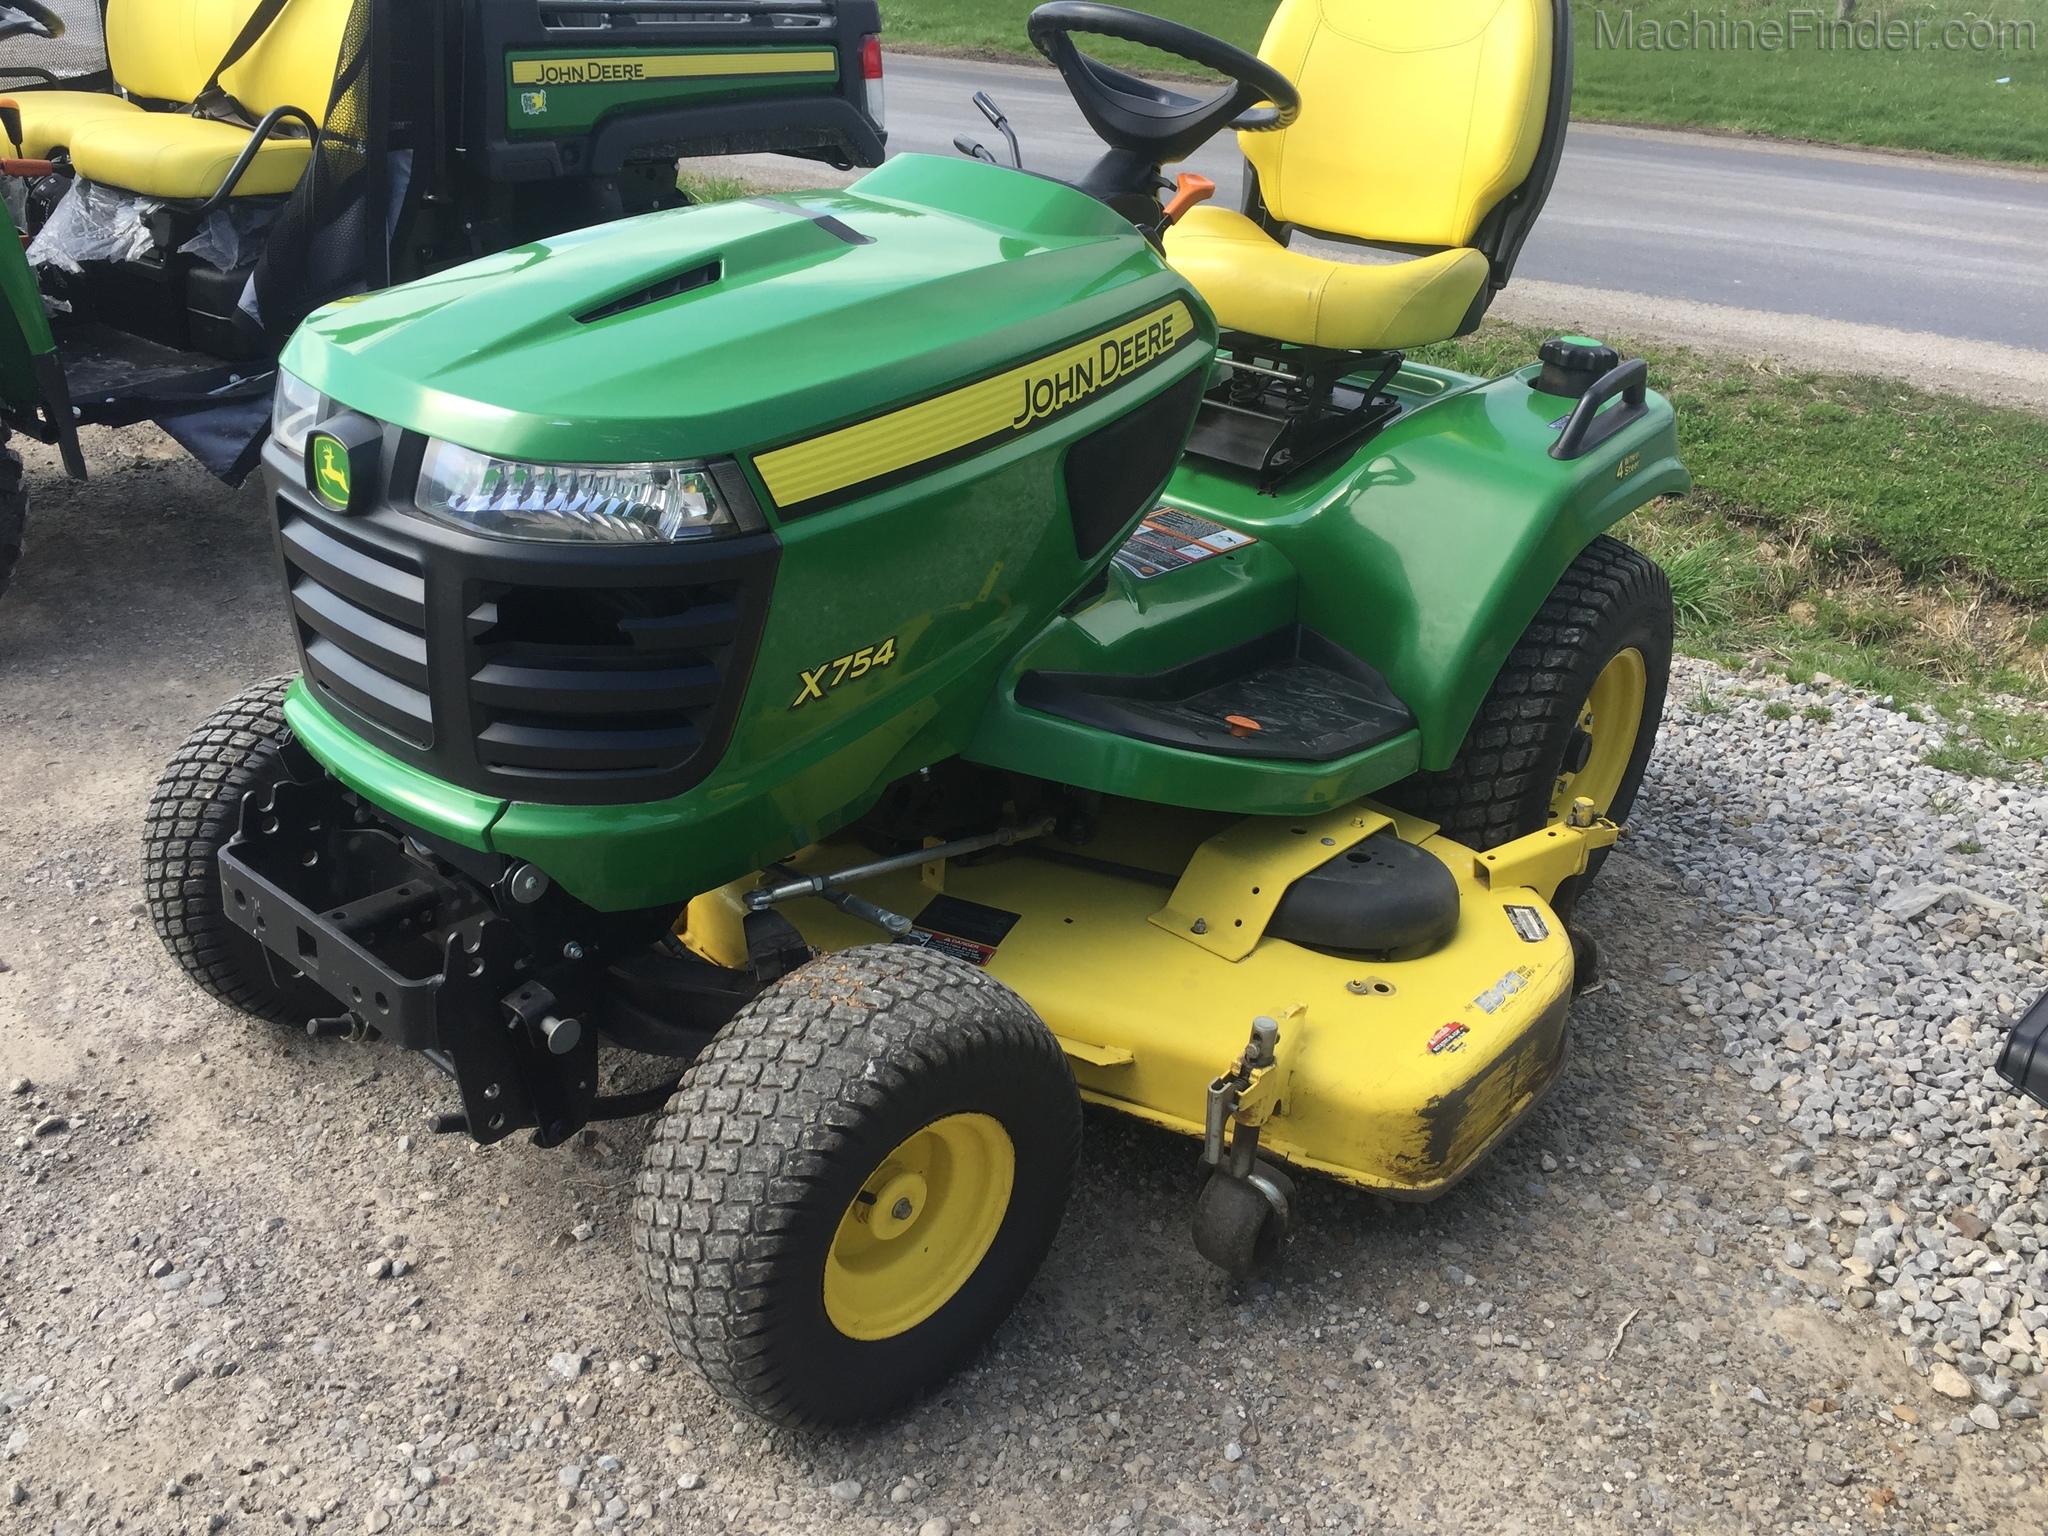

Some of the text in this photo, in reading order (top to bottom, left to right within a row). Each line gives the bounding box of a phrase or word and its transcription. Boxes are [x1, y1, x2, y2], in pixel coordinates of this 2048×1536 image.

[535, 62, 644, 83] JOHN DEERE
[1013, 314, 1175, 427] JOHN DEERE
[1616, 460, 1624, 478] 4
[792, 637, 896, 707] X754
[952, 938, 980, 950] DANGER
[1473, 970, 1528, 1014] EDGE
